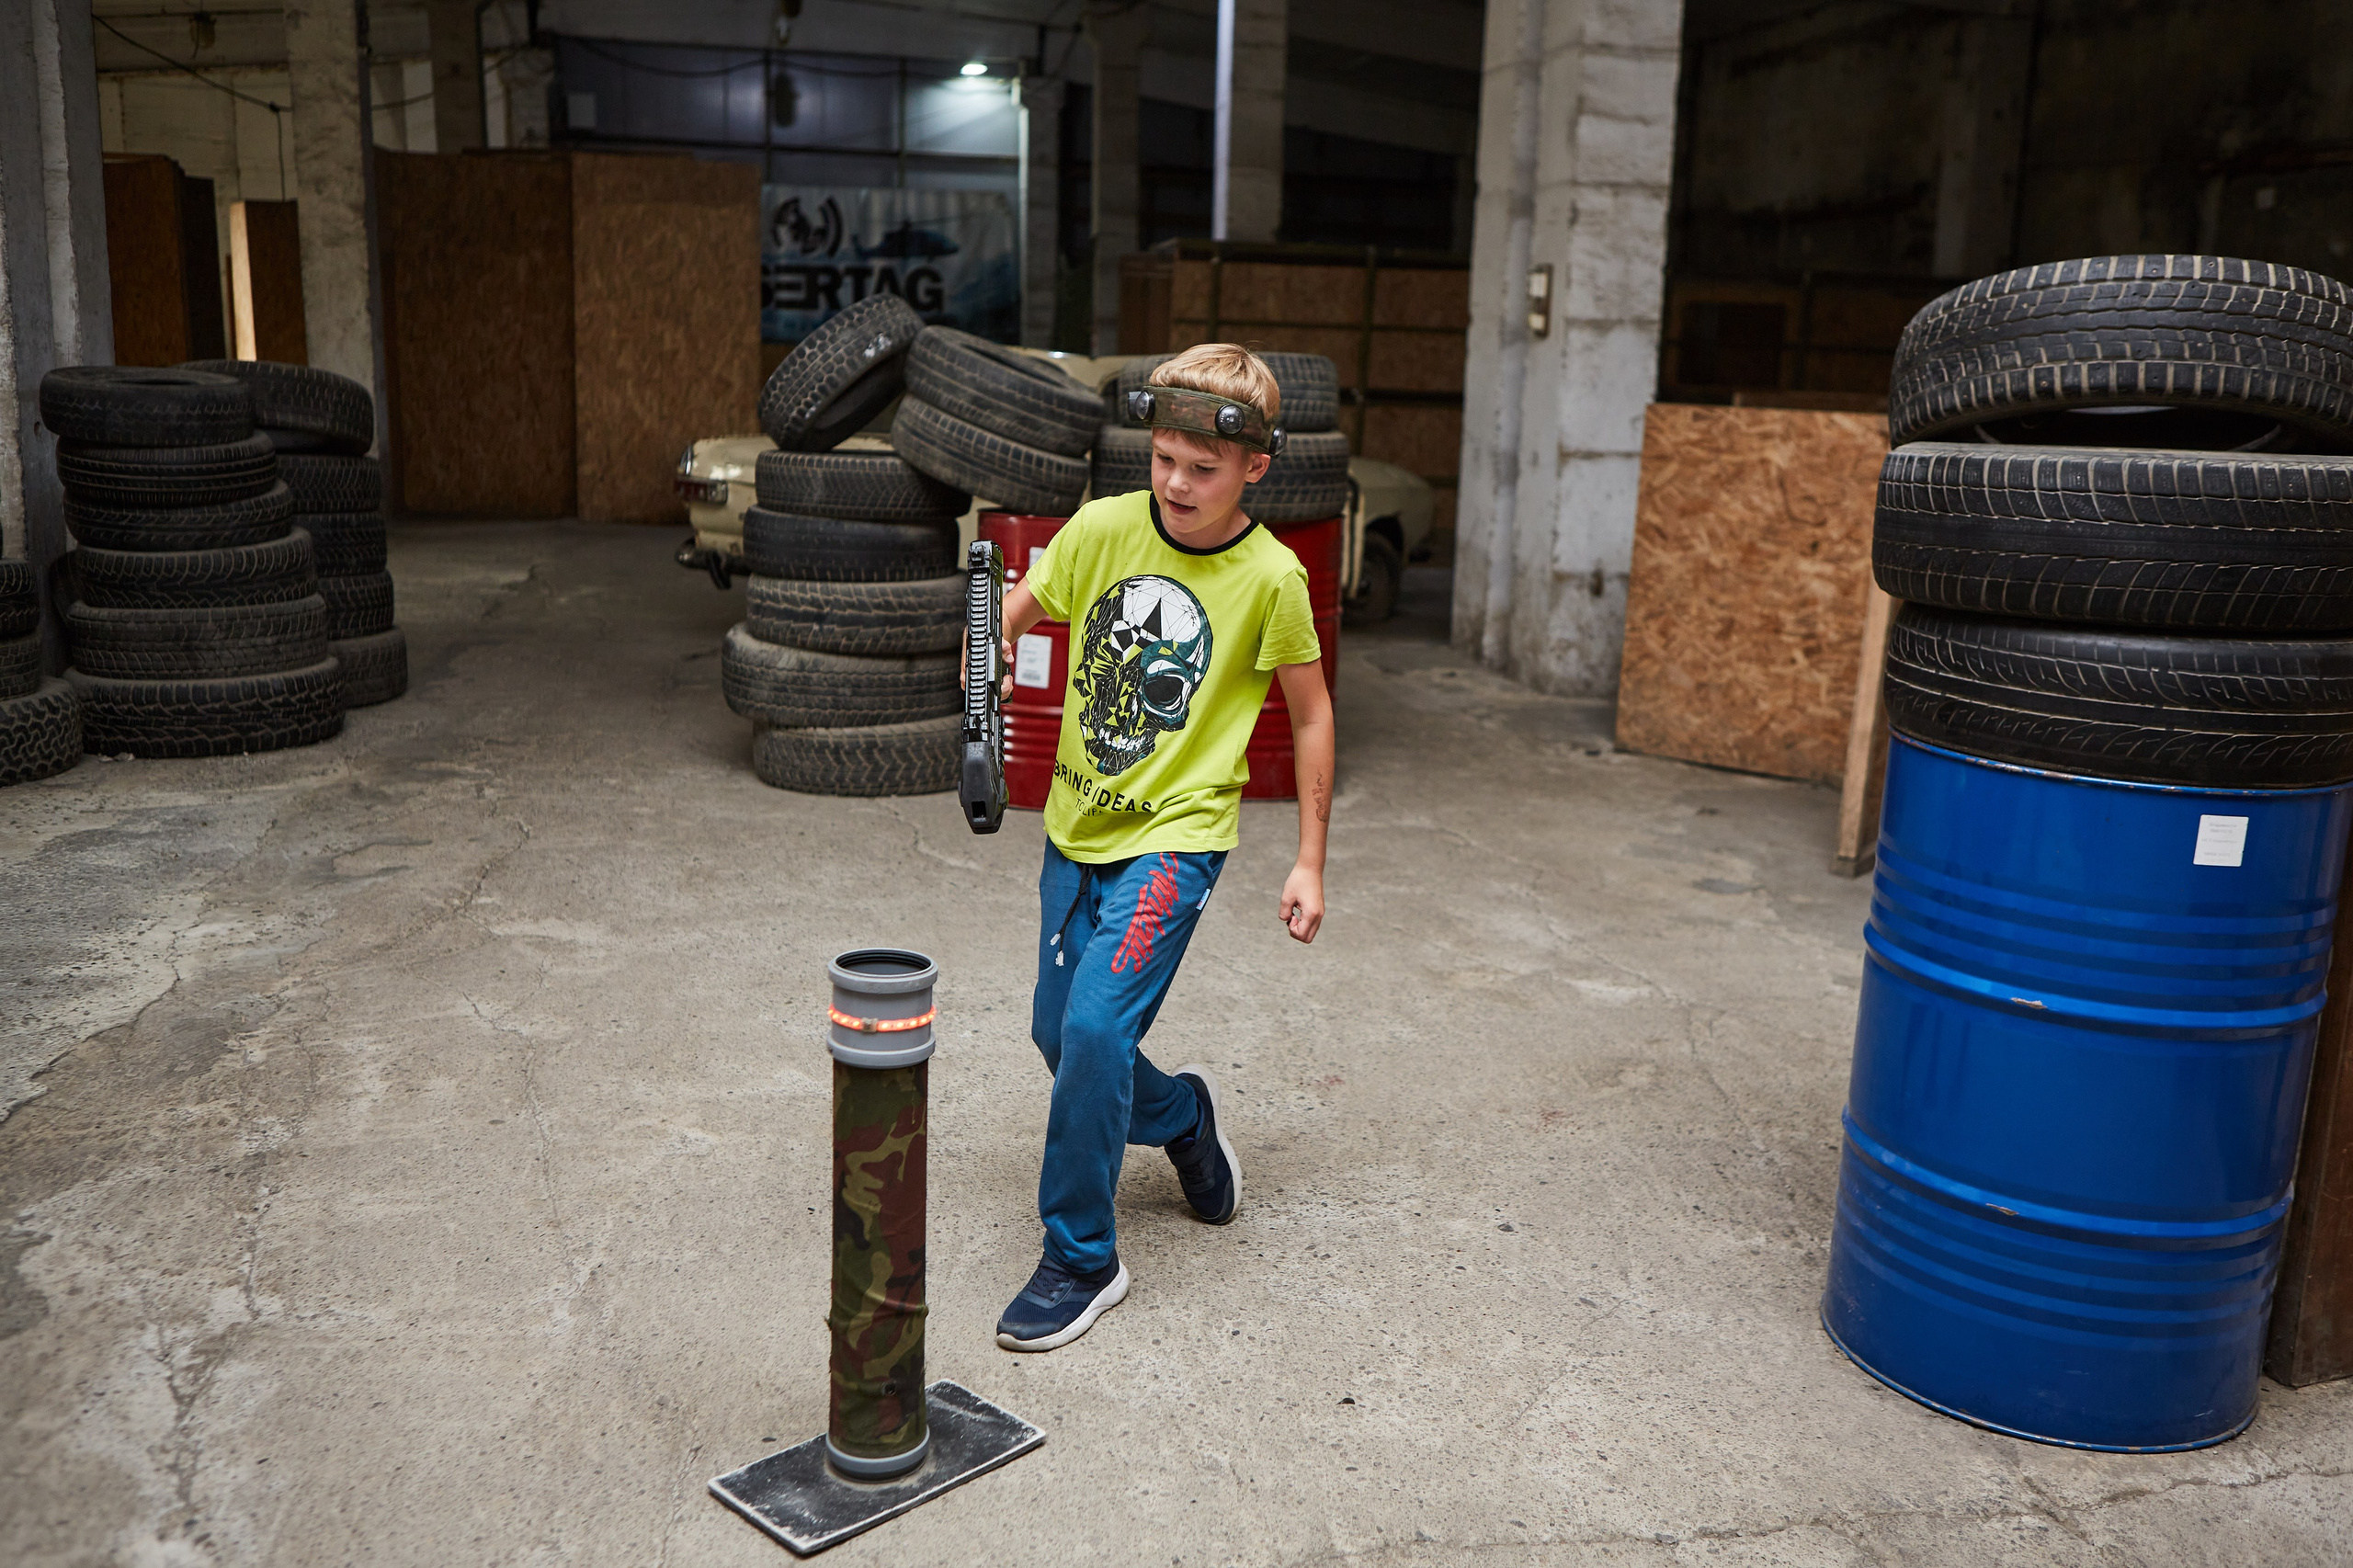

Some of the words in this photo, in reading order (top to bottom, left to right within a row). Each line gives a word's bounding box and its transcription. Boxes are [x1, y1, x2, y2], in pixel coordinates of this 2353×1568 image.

[1053, 759, 1093, 797] BRING
[1074, 797, 1085, 812] TO
[1110, 852, 1179, 974] Athletic
